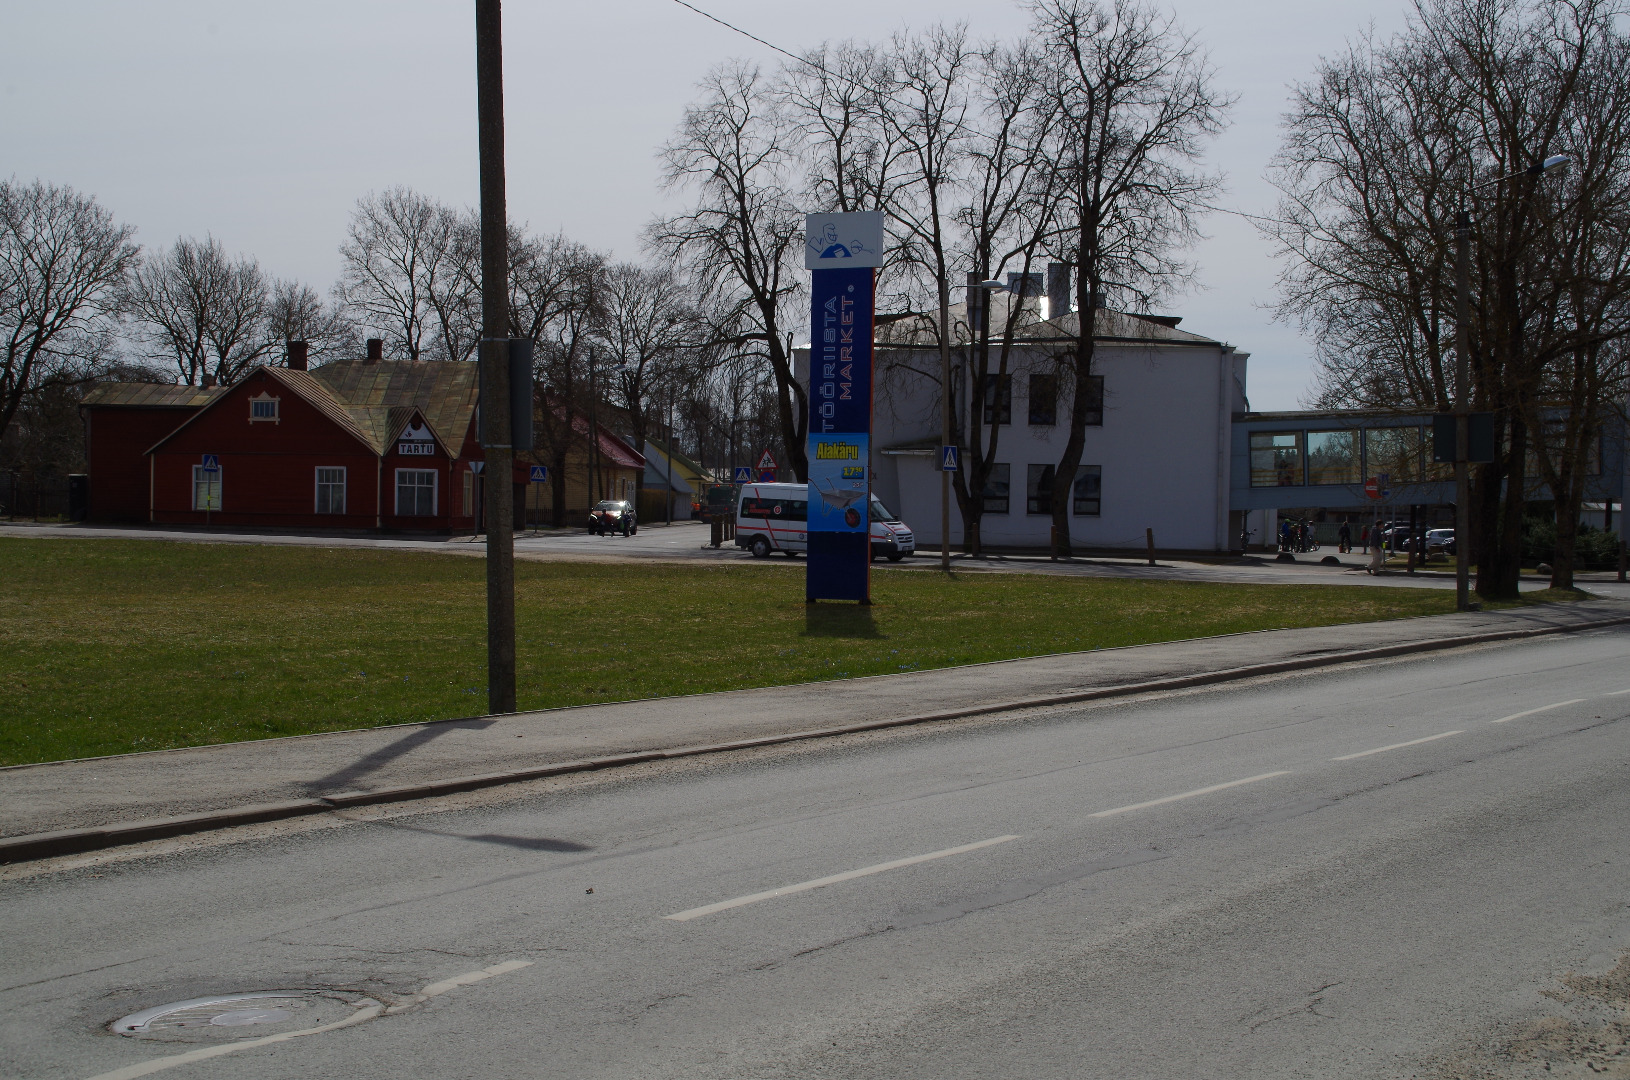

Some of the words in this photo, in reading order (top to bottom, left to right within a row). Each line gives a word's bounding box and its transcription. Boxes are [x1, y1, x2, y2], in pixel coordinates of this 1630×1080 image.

[820, 297, 837, 433] TÖÖRIISTA
[400, 444, 432, 454] TARTU
[816, 442, 858, 460] Aiakäru
